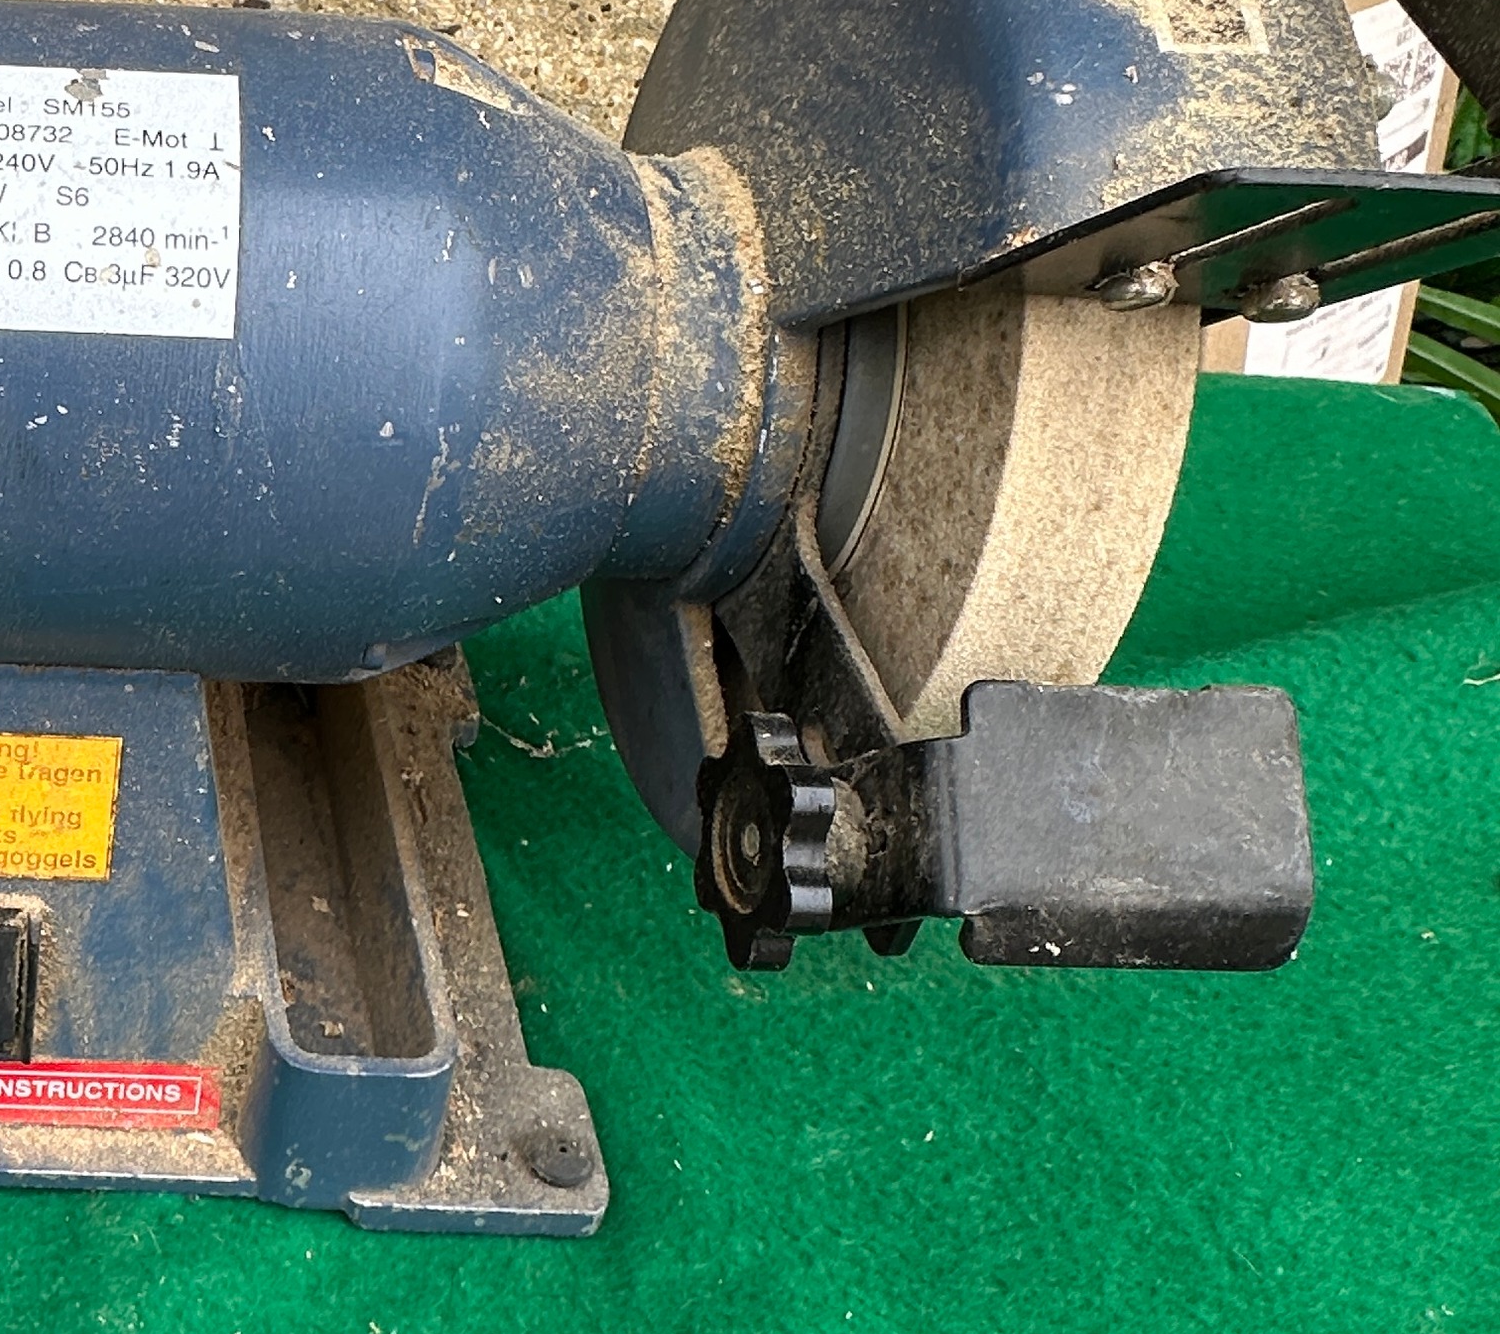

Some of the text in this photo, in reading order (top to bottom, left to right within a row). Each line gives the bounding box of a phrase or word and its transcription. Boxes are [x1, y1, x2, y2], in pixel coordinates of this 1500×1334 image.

[43, 98, 131, 118] SM155
[114, 127, 188, 149] E-Mot
[56, 185, 90, 207] S6
[34, 223, 51, 243] B
[92, 226, 155, 249] 2840
[8, 258, 46, 281] 0.8
[164, 265, 231, 289] 320V
